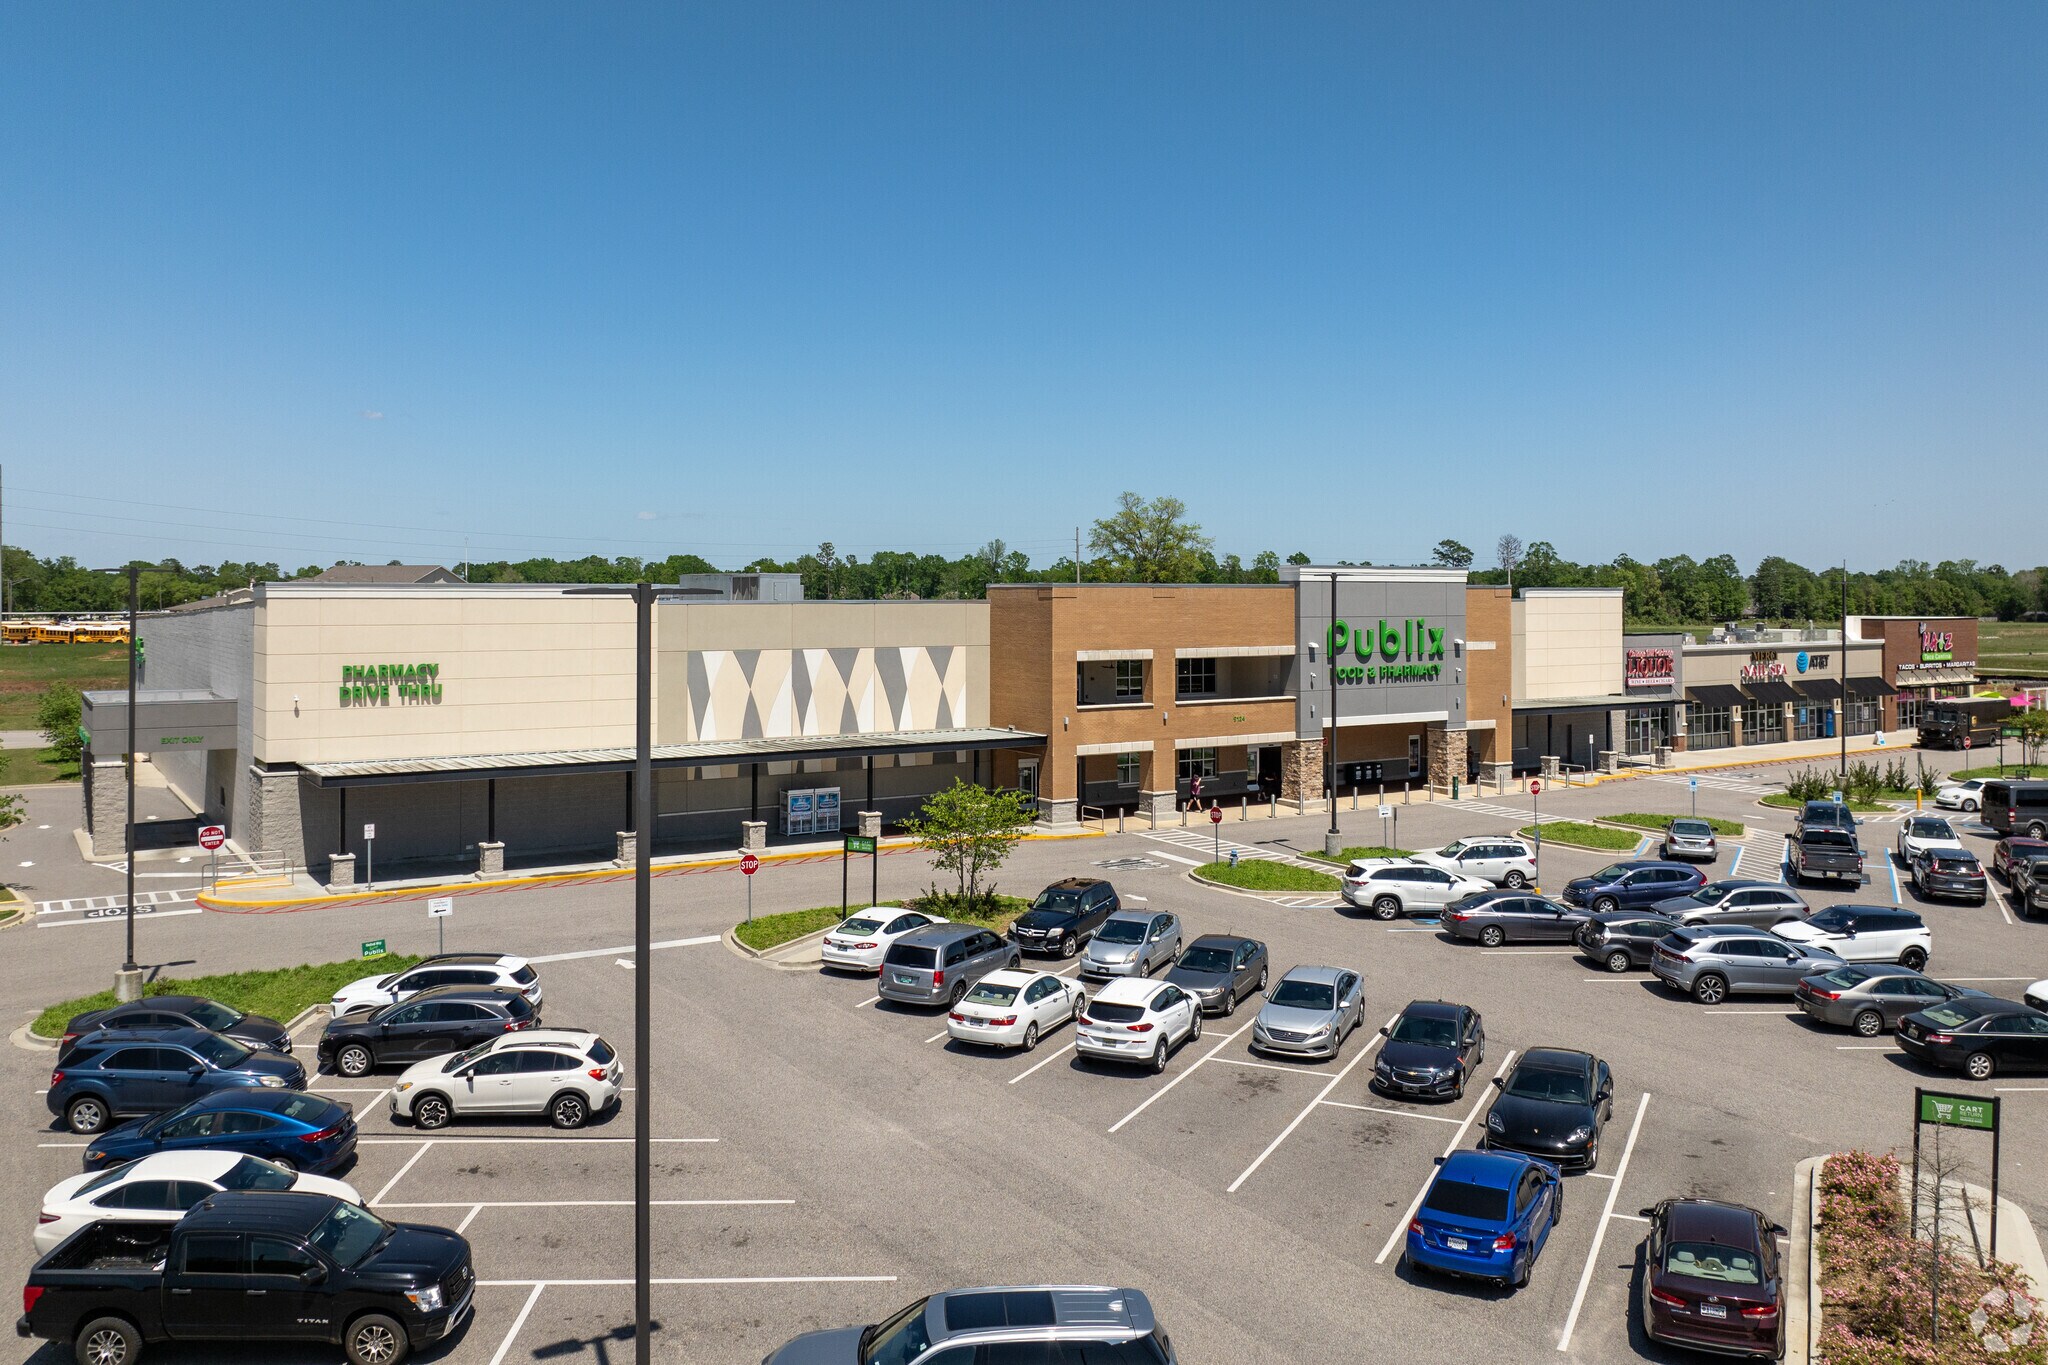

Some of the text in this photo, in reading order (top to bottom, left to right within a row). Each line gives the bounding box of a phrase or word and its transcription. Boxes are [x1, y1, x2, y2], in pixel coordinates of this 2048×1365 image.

[1327, 618, 1445, 658] Publix
[1628, 658, 1675, 678] LIQUOR
[1809, 654, 1830, 668] AT&T
[342, 663, 439, 678] PHARMACY
[1331, 666, 1364, 678] OOD
[1381, 664, 1443, 677] PHARMACY
[1742, 663, 1788, 677] NAIL SPA
[340, 683, 443, 699] DRIVE THRU
[182, 735, 204, 744] ONLY
[741, 860, 758, 870] STOP
[1959, 1104, 1984, 1113] CART
[1959, 1110, 1983, 1118] RETURN
